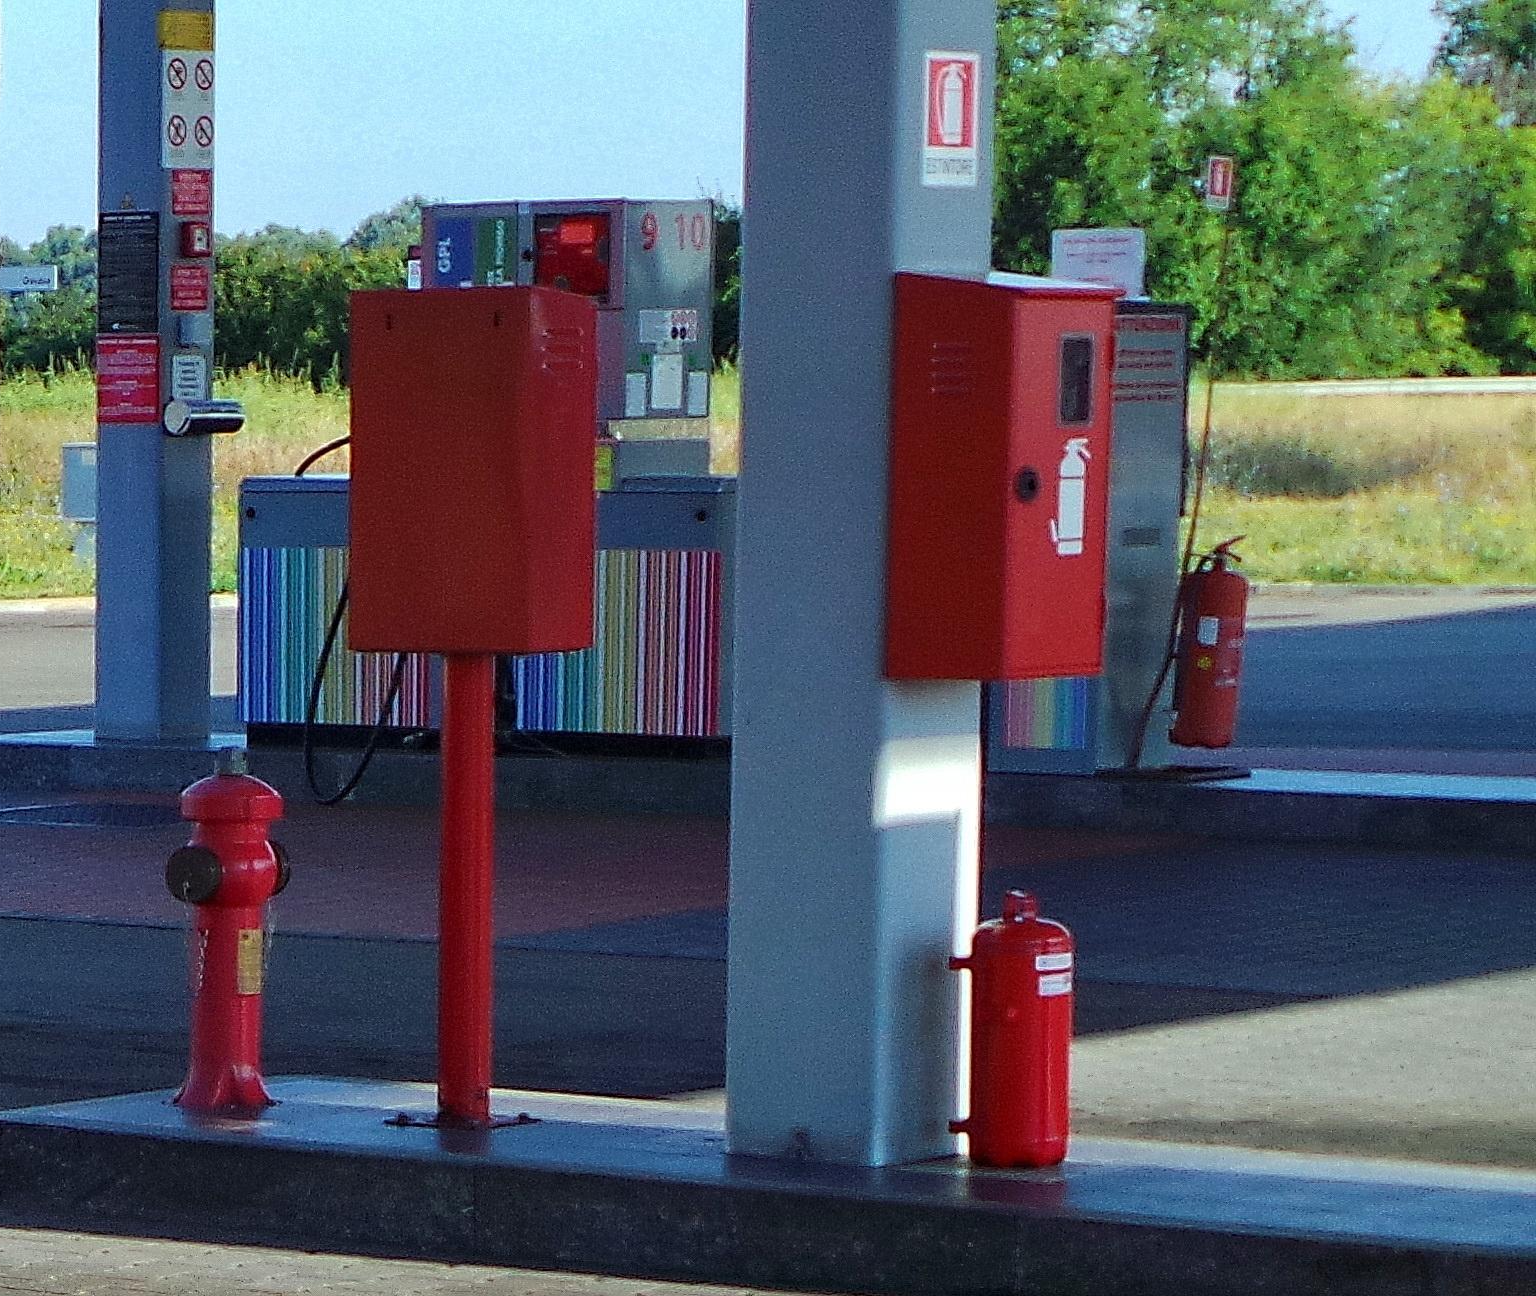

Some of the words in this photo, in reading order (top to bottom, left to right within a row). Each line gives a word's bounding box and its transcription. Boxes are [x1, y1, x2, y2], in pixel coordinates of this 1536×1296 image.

[640, 212, 659, 251] 9
[674, 212, 705, 251] 10
[437, 236, 452, 273] GPL
